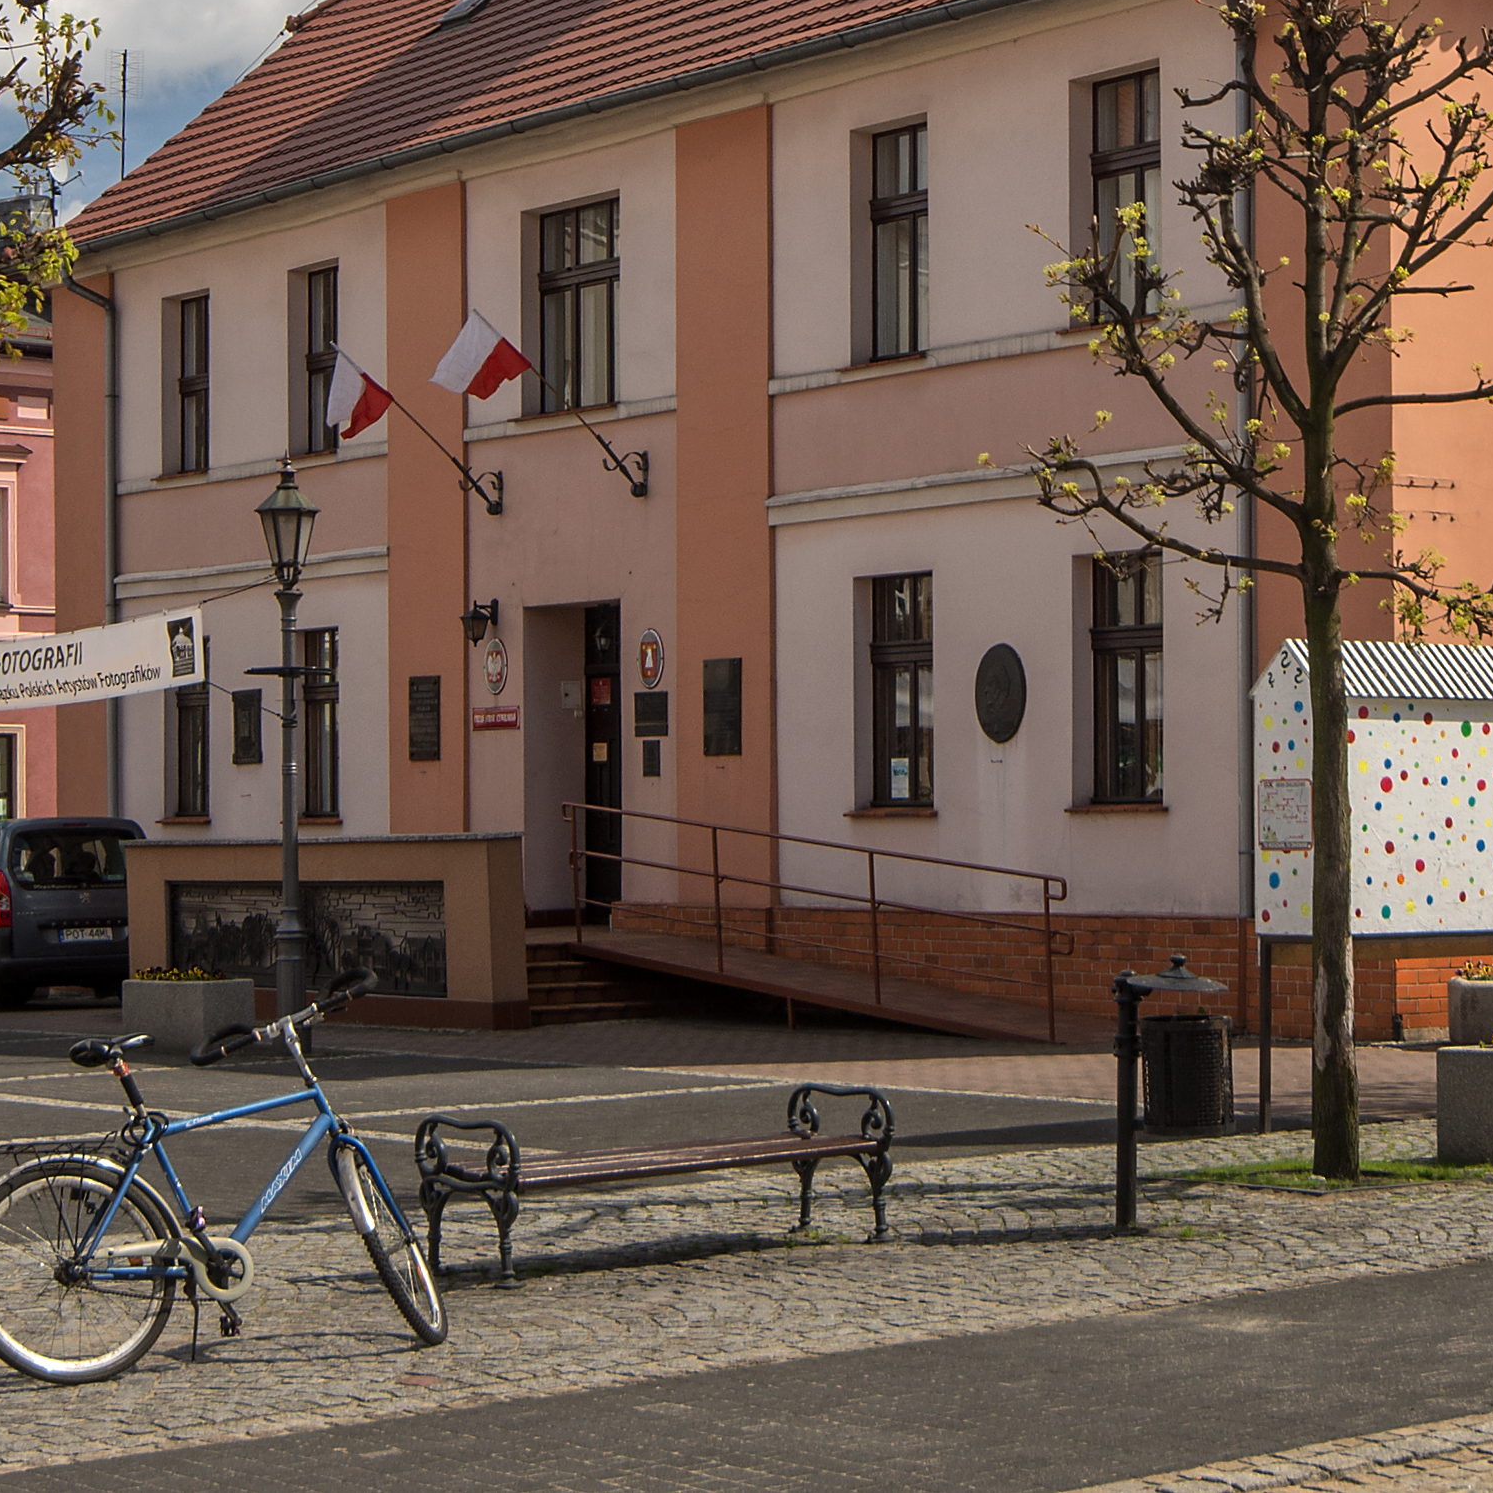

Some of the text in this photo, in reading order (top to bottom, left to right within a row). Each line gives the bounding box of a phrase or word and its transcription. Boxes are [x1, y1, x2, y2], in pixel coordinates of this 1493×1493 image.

[19, 678, 57, 698] Polskich
[56, 674, 97, 696] Artystów
[97, 663, 161, 689] Fotografików
[66, 929, 86, 940] POT
[261, 1148, 303, 1215] MAXIM
